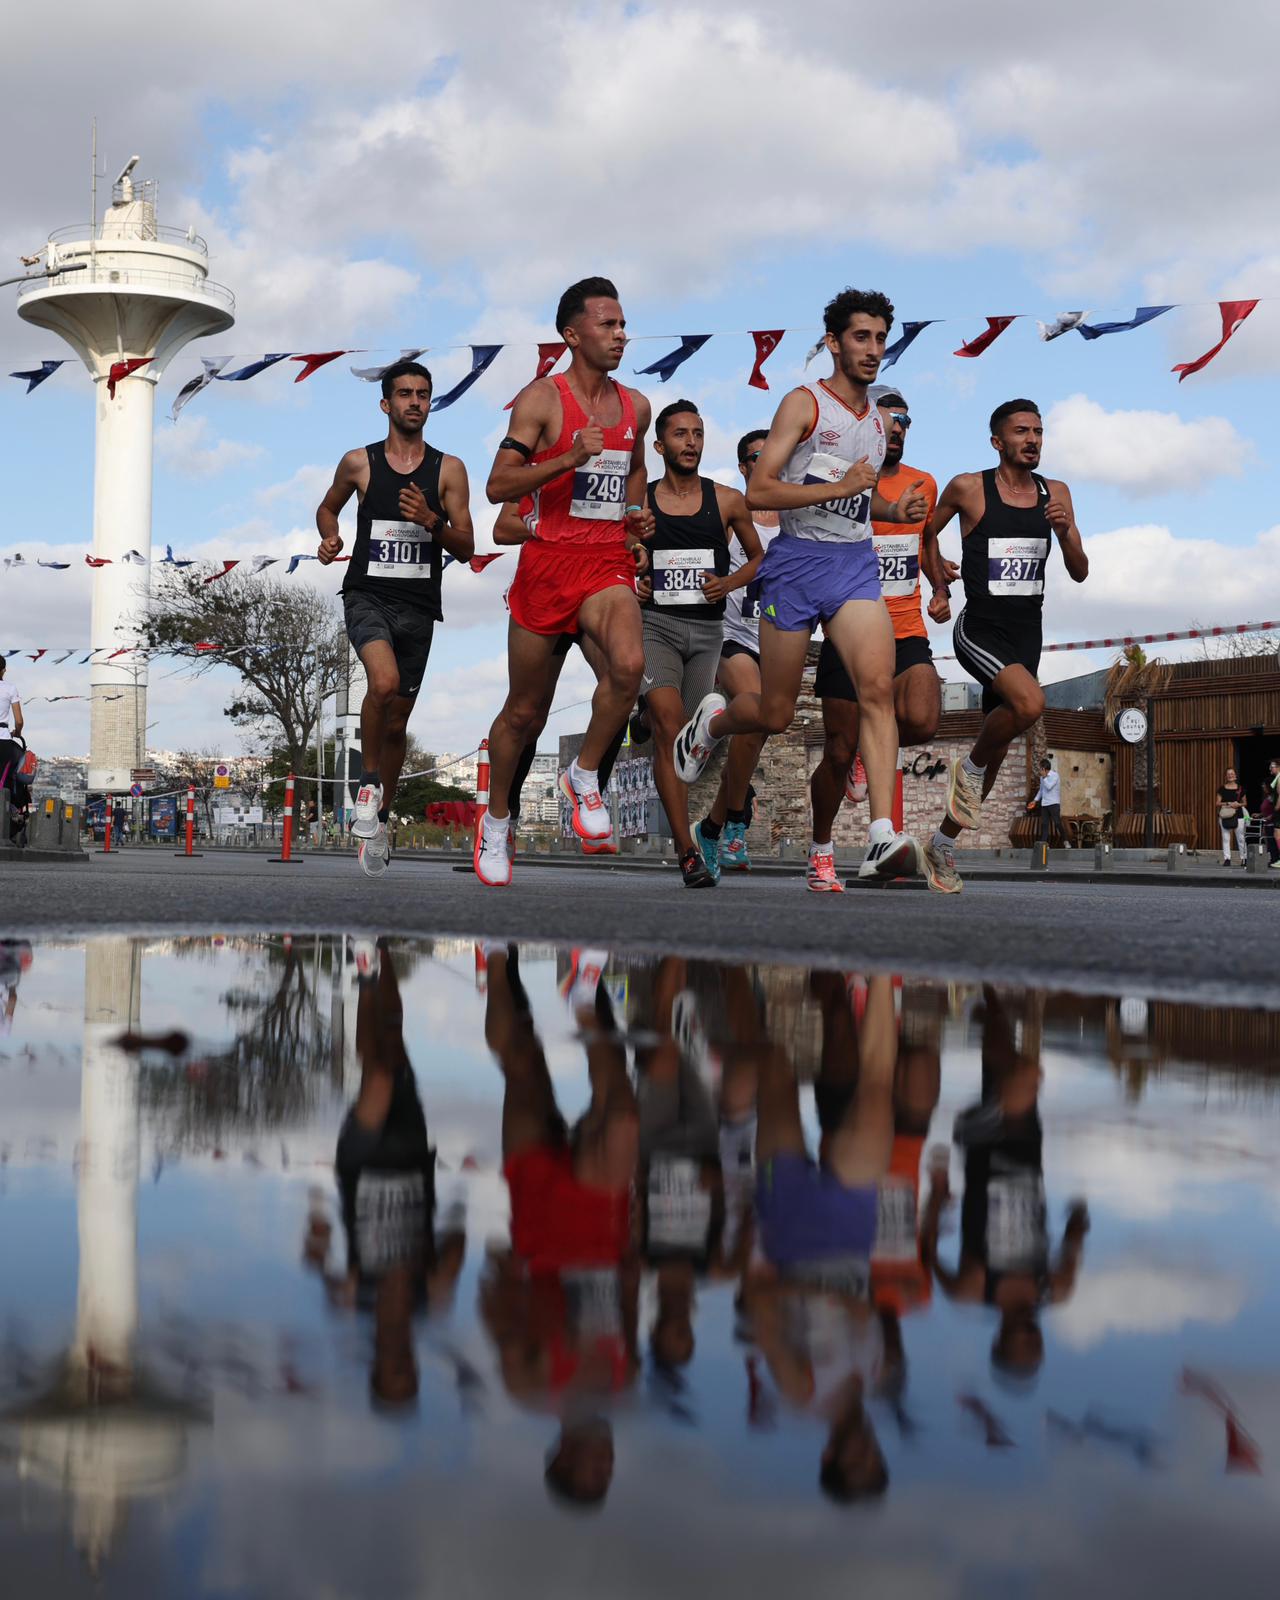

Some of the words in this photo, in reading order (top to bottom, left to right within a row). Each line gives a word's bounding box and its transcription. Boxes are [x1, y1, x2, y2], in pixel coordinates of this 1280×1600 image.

[379, 540, 421, 564] 3101
[664, 569, 706, 590] 3845
[1000, 558, 1040, 580] 2377
